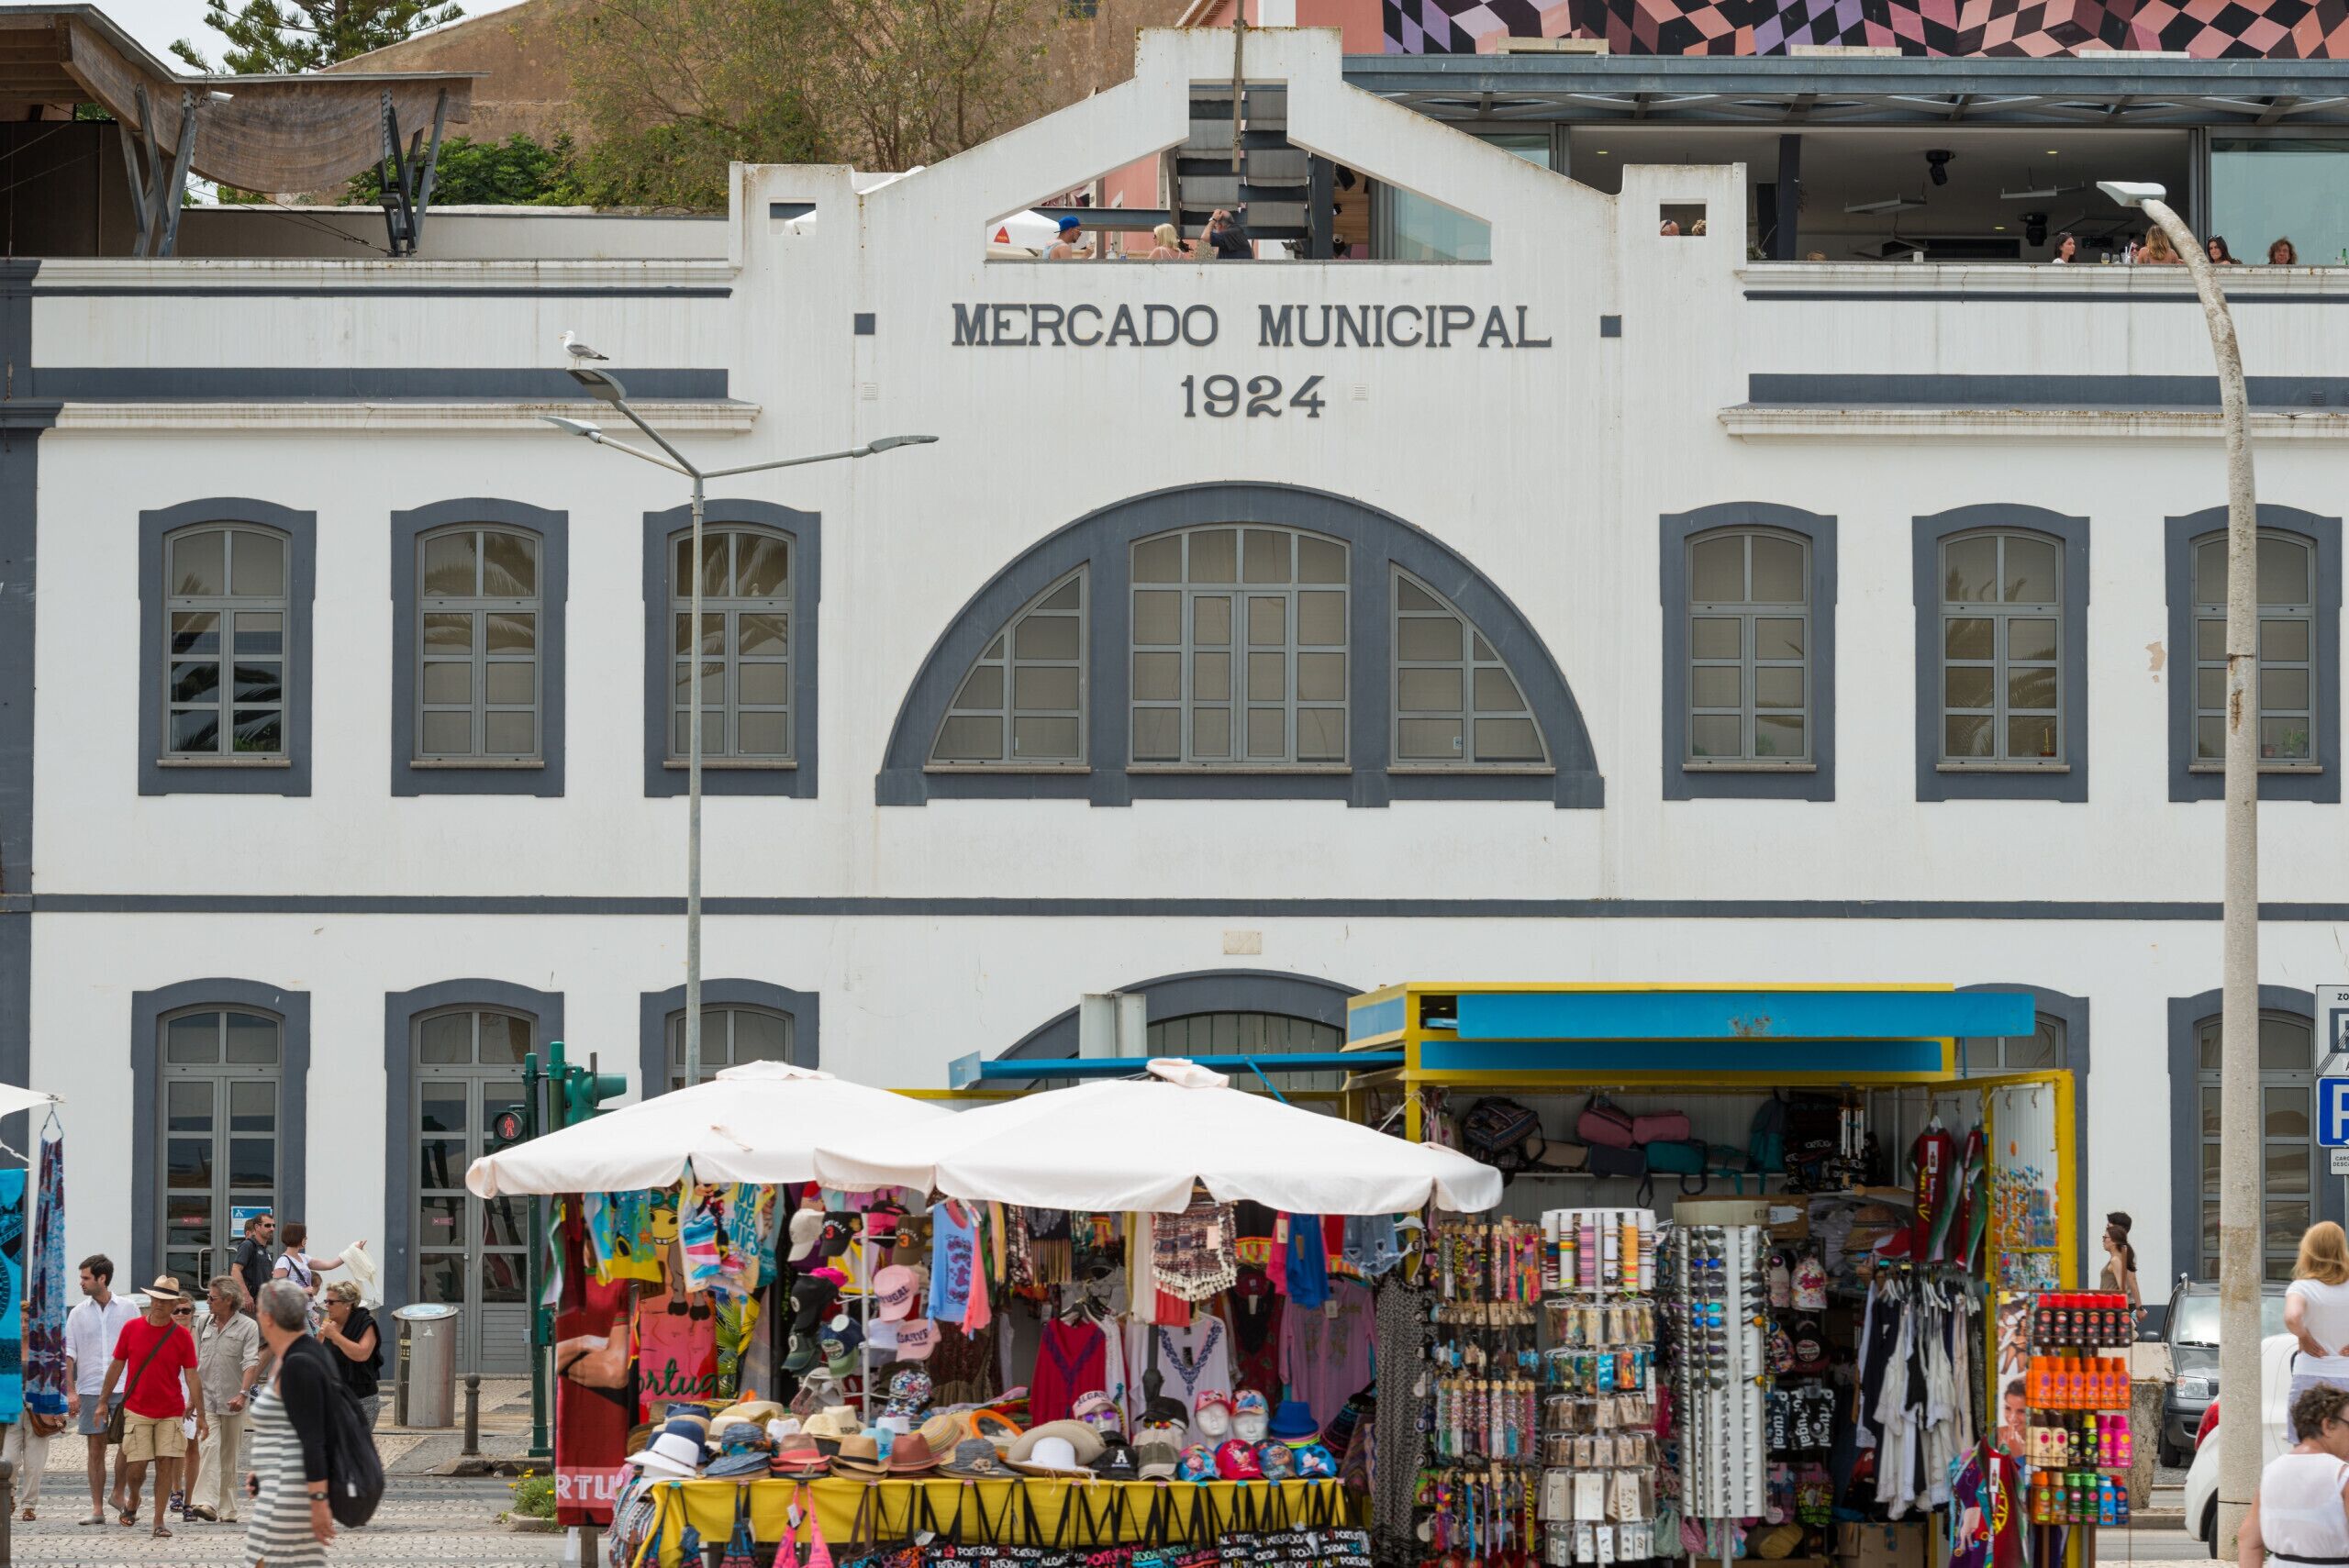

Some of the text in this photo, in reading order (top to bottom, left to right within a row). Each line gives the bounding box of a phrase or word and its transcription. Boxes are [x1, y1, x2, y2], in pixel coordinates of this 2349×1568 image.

[952, 303, 1553, 348] MERCADO MUNICIPAL
[1181, 374, 1326, 418] 1924
[825, 1225, 835, 1240] 3
[899, 1233, 910, 1248] 3
